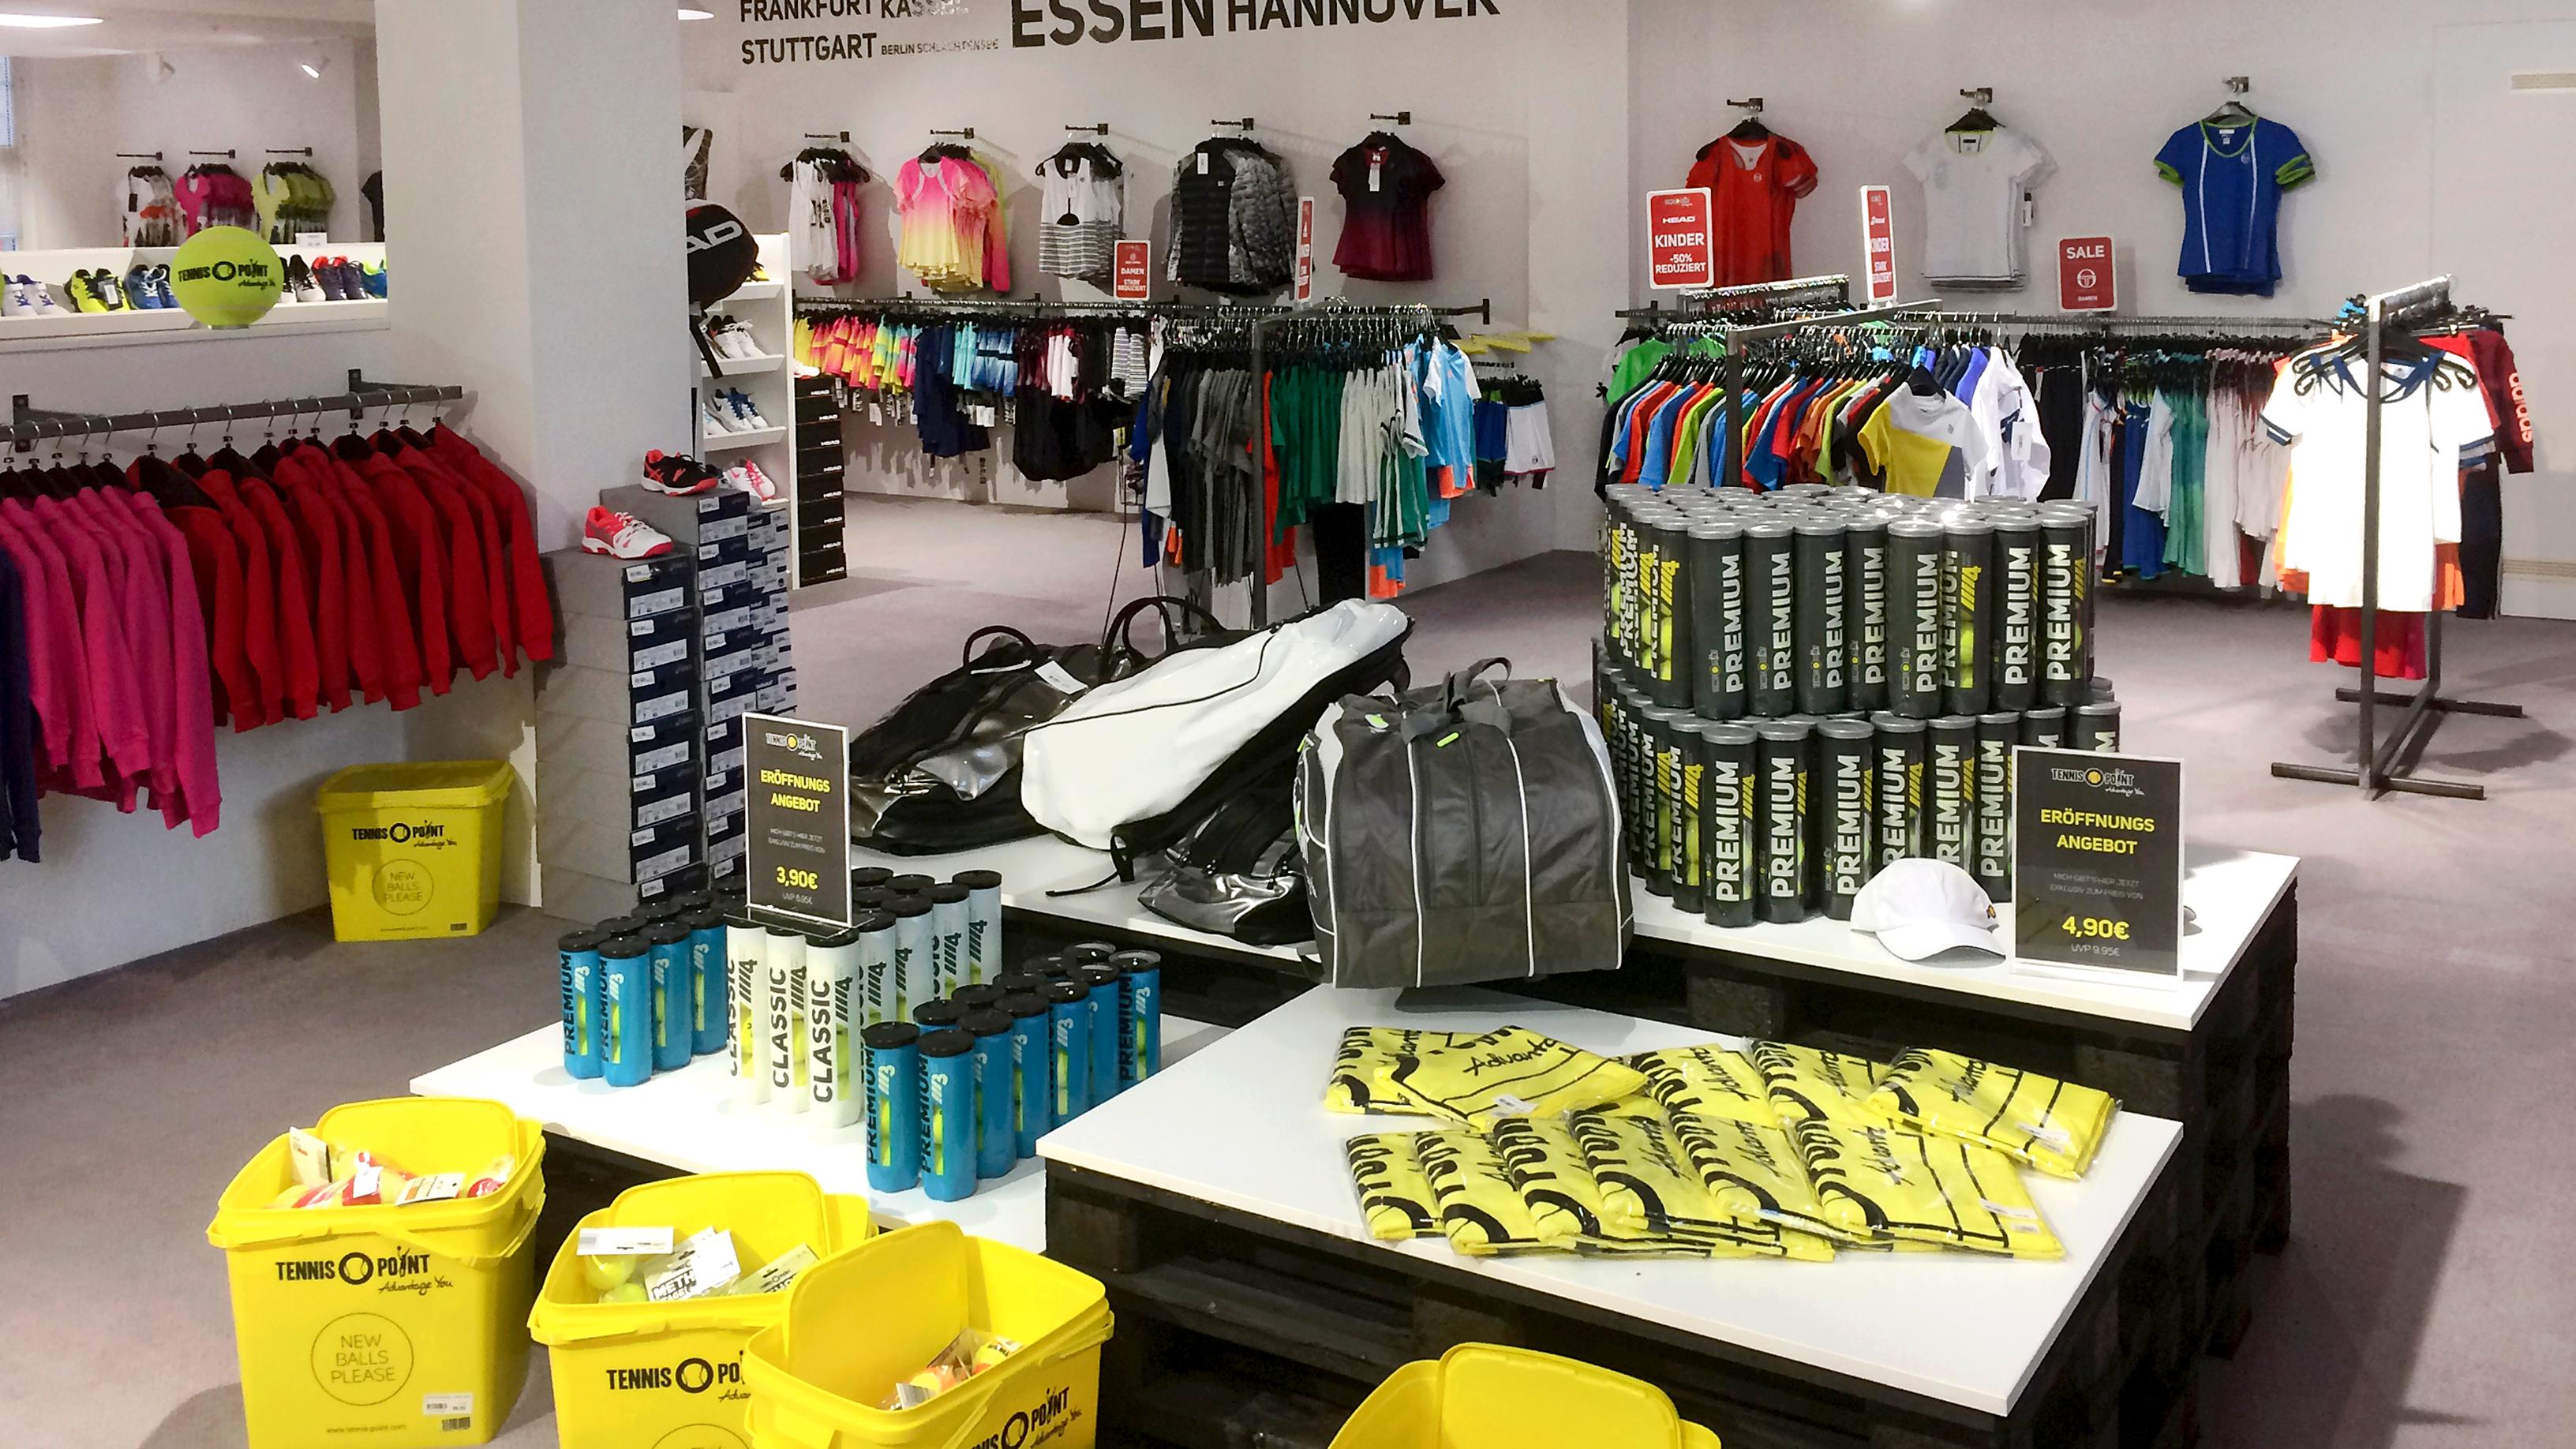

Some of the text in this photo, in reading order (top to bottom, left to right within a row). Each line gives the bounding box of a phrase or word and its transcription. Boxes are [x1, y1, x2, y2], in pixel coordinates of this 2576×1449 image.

[1012, 0, 1215, 48] ESSEN
[741, 32, 998, 65] STUTTGART BERLIN SCHHTENSEE
[687, 220, 743, 254] AD
[1662, 215, 1696, 224] HEAD
[1654, 232, 1705, 248] KINDER
[2066, 245, 2106, 259] SALE
[178, 266, 211, 282] TENNIS
[1655, 262, 1706, 274] REDUZIERT
[1669, 253, 1693, 264] -50%
[1721, 554, 1743, 692] PREMIUM
[1771, 552, 1792, 690] PREMIUM
[1825, 550, 1843, 688] PREMIUM
[1863, 548, 1885, 683] PREMIUM
[1916, 554, 1938, 691] PREMIUM
[2005, 548, 2031, 684] PREMIUM
[2046, 544, 2072, 680] PREMIUM
[760, 769, 831, 793] ERÖFFNUNGS
[2050, 768, 2135, 787] TENNIS POINT
[770, 792, 821, 813] ANGEBOT
[1642, 732, 1656, 869] PREMIUM
[1669, 746, 1683, 885] PREMIUM
[1882, 748, 1906, 865] REMIUM
[1935, 744, 1960, 863] REMIUM
[1981, 739, 2005, 878] PREMIUM
[352, 820, 444, 841] TENNIS POINT
[1715, 760, 1739, 902] PREMIUM
[1771, 758, 1795, 898] PREMIUM
[1837, 754, 1862, 895] PREMIUM
[2040, 807, 2155, 833] ERÖFFNUNGS
[2056, 834, 2138, 855] ANGEBOT
[387, 881, 419, 890] BALLS
[390, 871, 415, 881] NEW
[776, 866, 818, 891] 3,90€
[384, 892, 423, 902] PLEASE
[2061, 915, 2130, 940] 4,90€
[2071, 944, 2091, 953] UVP
[560, 952, 576, 1055] PREMIUM
[769, 966, 789, 1088] CLASSIC
[812, 979, 833, 1103] CLASSIC
[1118, 975, 1133, 1082] PREMIUM
[1463, 1036, 1559, 1076] Advanta
[867, 1047, 878, 1165] PREMIUM
[919, 1054, 932, 1174] PREMIUM
[275, 1245, 431, 1282] TENNIS POINT
[379, 1275, 454, 1295] Advantage You
[335, 1350, 389, 1366] BALLS
[340, 1334, 382, 1349] NEW
[330, 1367, 396, 1384] PLEASE
[606, 1367, 672, 1390] TENNIS
[1031, 1387, 1069, 1432] POINT
